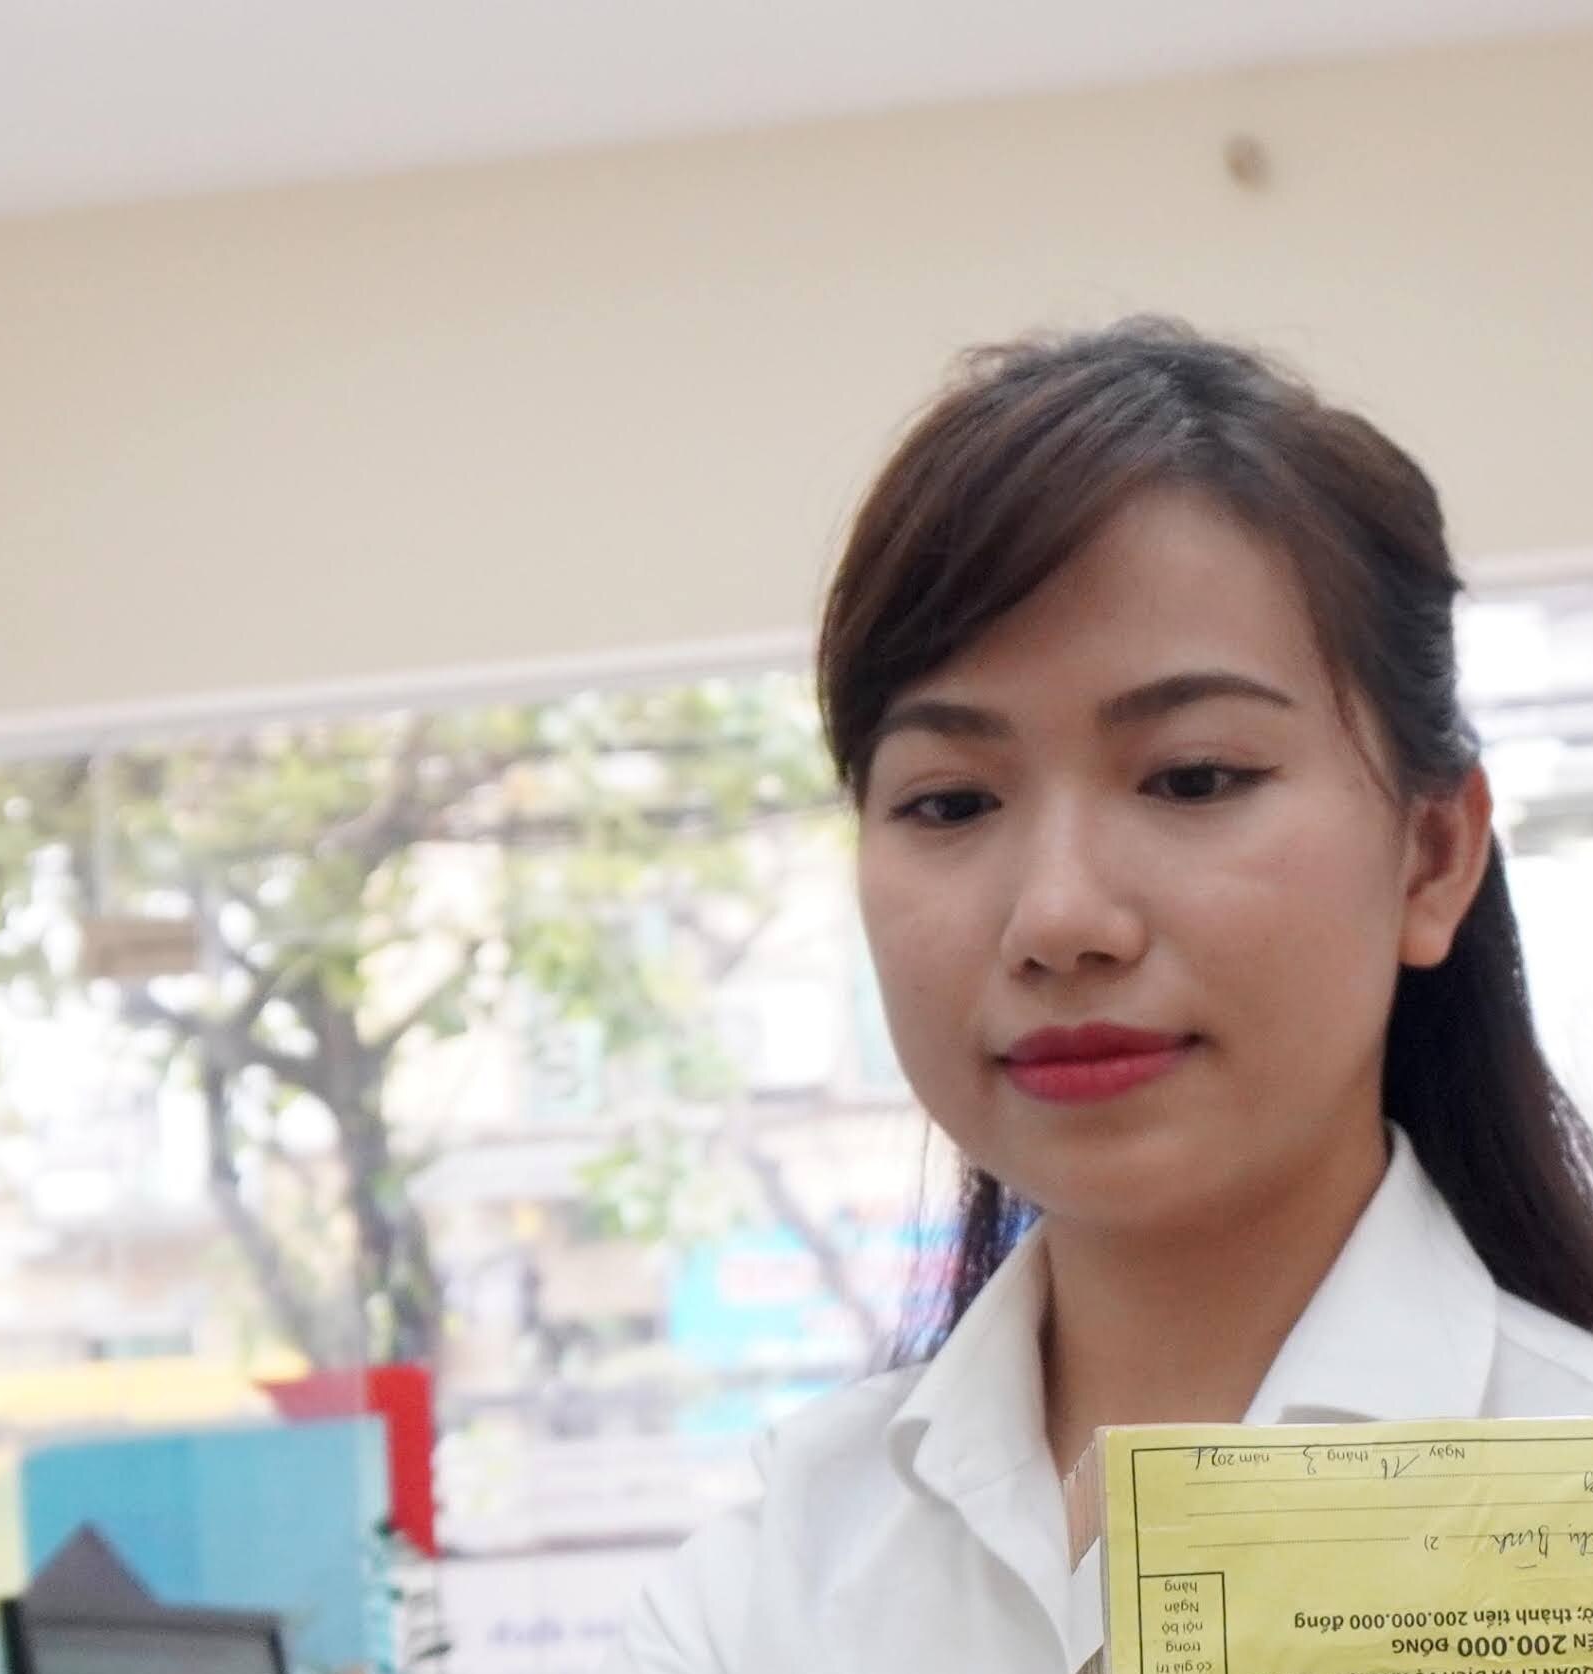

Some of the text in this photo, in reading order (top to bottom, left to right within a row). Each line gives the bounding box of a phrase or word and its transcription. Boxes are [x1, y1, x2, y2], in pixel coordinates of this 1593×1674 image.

[1326, 1448, 1369, 1463] tháng
[1429, 1444, 1465, 1459] Ngày
[1239, 1453, 1270, 1466] năm
[1423, 1534, 1439, 1551] 2)
[1164, 1579, 1197, 1593] hàng
[1164, 1598, 1199, 1613] Ngân
[1294, 1612, 1344, 1632] đồng
[1350, 1610, 1468, 1631] 200.000.000
[1473, 1610, 1510, 1629] tiền
[1516, 1608, 1572, 1627] thành
[1161, 1620, 1203, 1634] nội bộ
[1165, 1640, 1201, 1653] trong
[1391, 1637, 1449, 1657] ĐỒNG
[1457, 1634, 1567, 1657] 200.000
[1156, 1659, 1212, 1674] có giá trị
